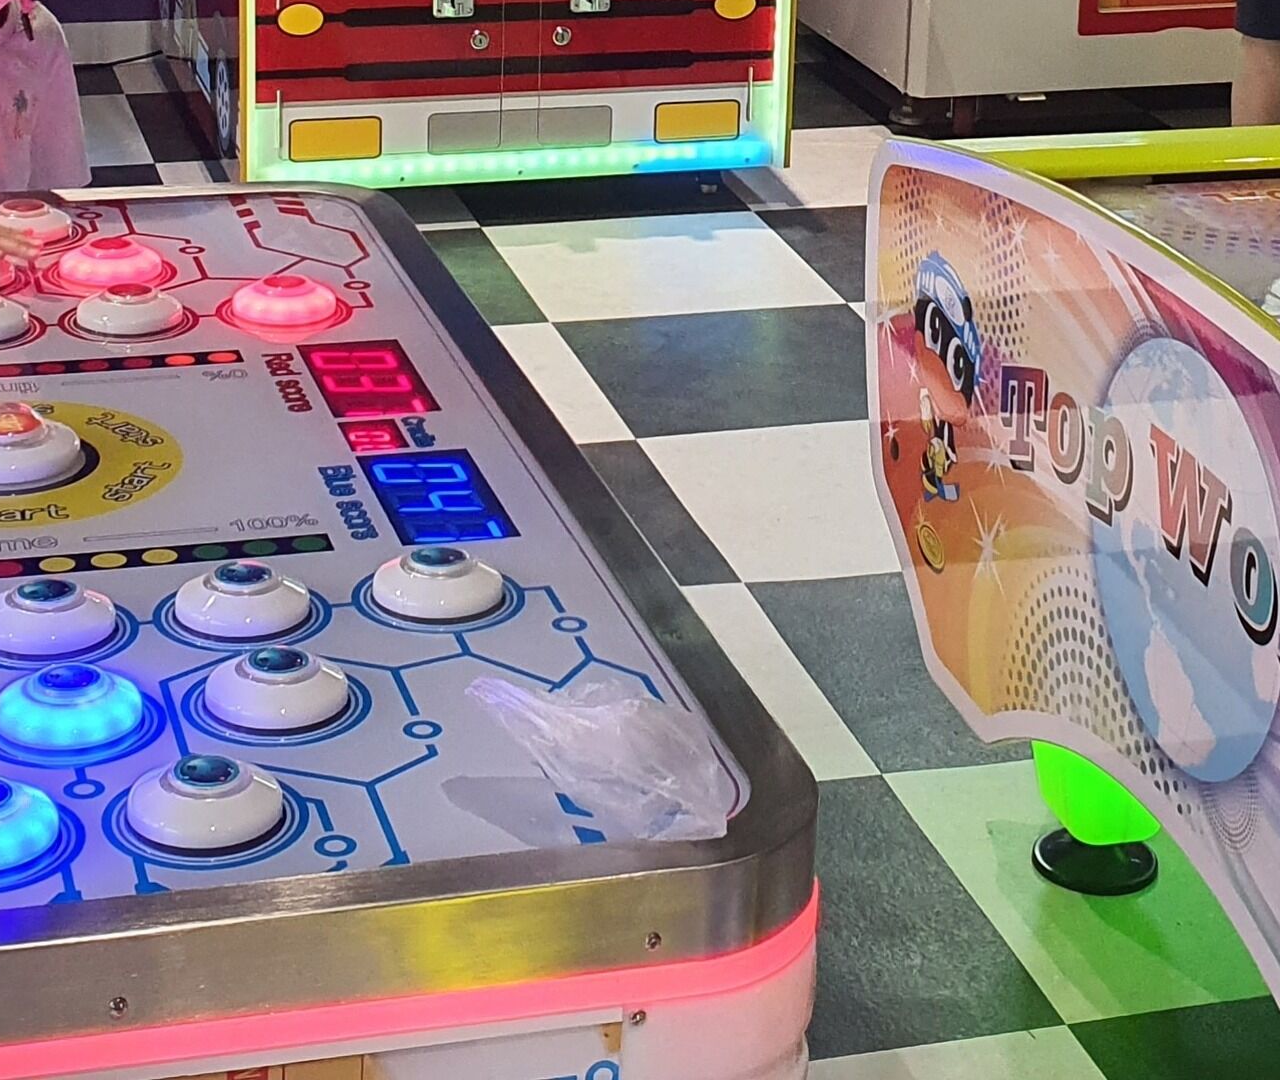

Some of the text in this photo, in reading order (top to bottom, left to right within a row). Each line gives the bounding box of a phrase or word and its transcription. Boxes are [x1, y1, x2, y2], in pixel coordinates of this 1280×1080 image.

[261, 352, 302, 377] Red
[86, 412, 164, 448] start
[1000, 365, 1135, 527] Top
[103, 460, 172, 503] start
[318, 464, 357, 497] Blue
[230, 512, 319, 532] 100%
